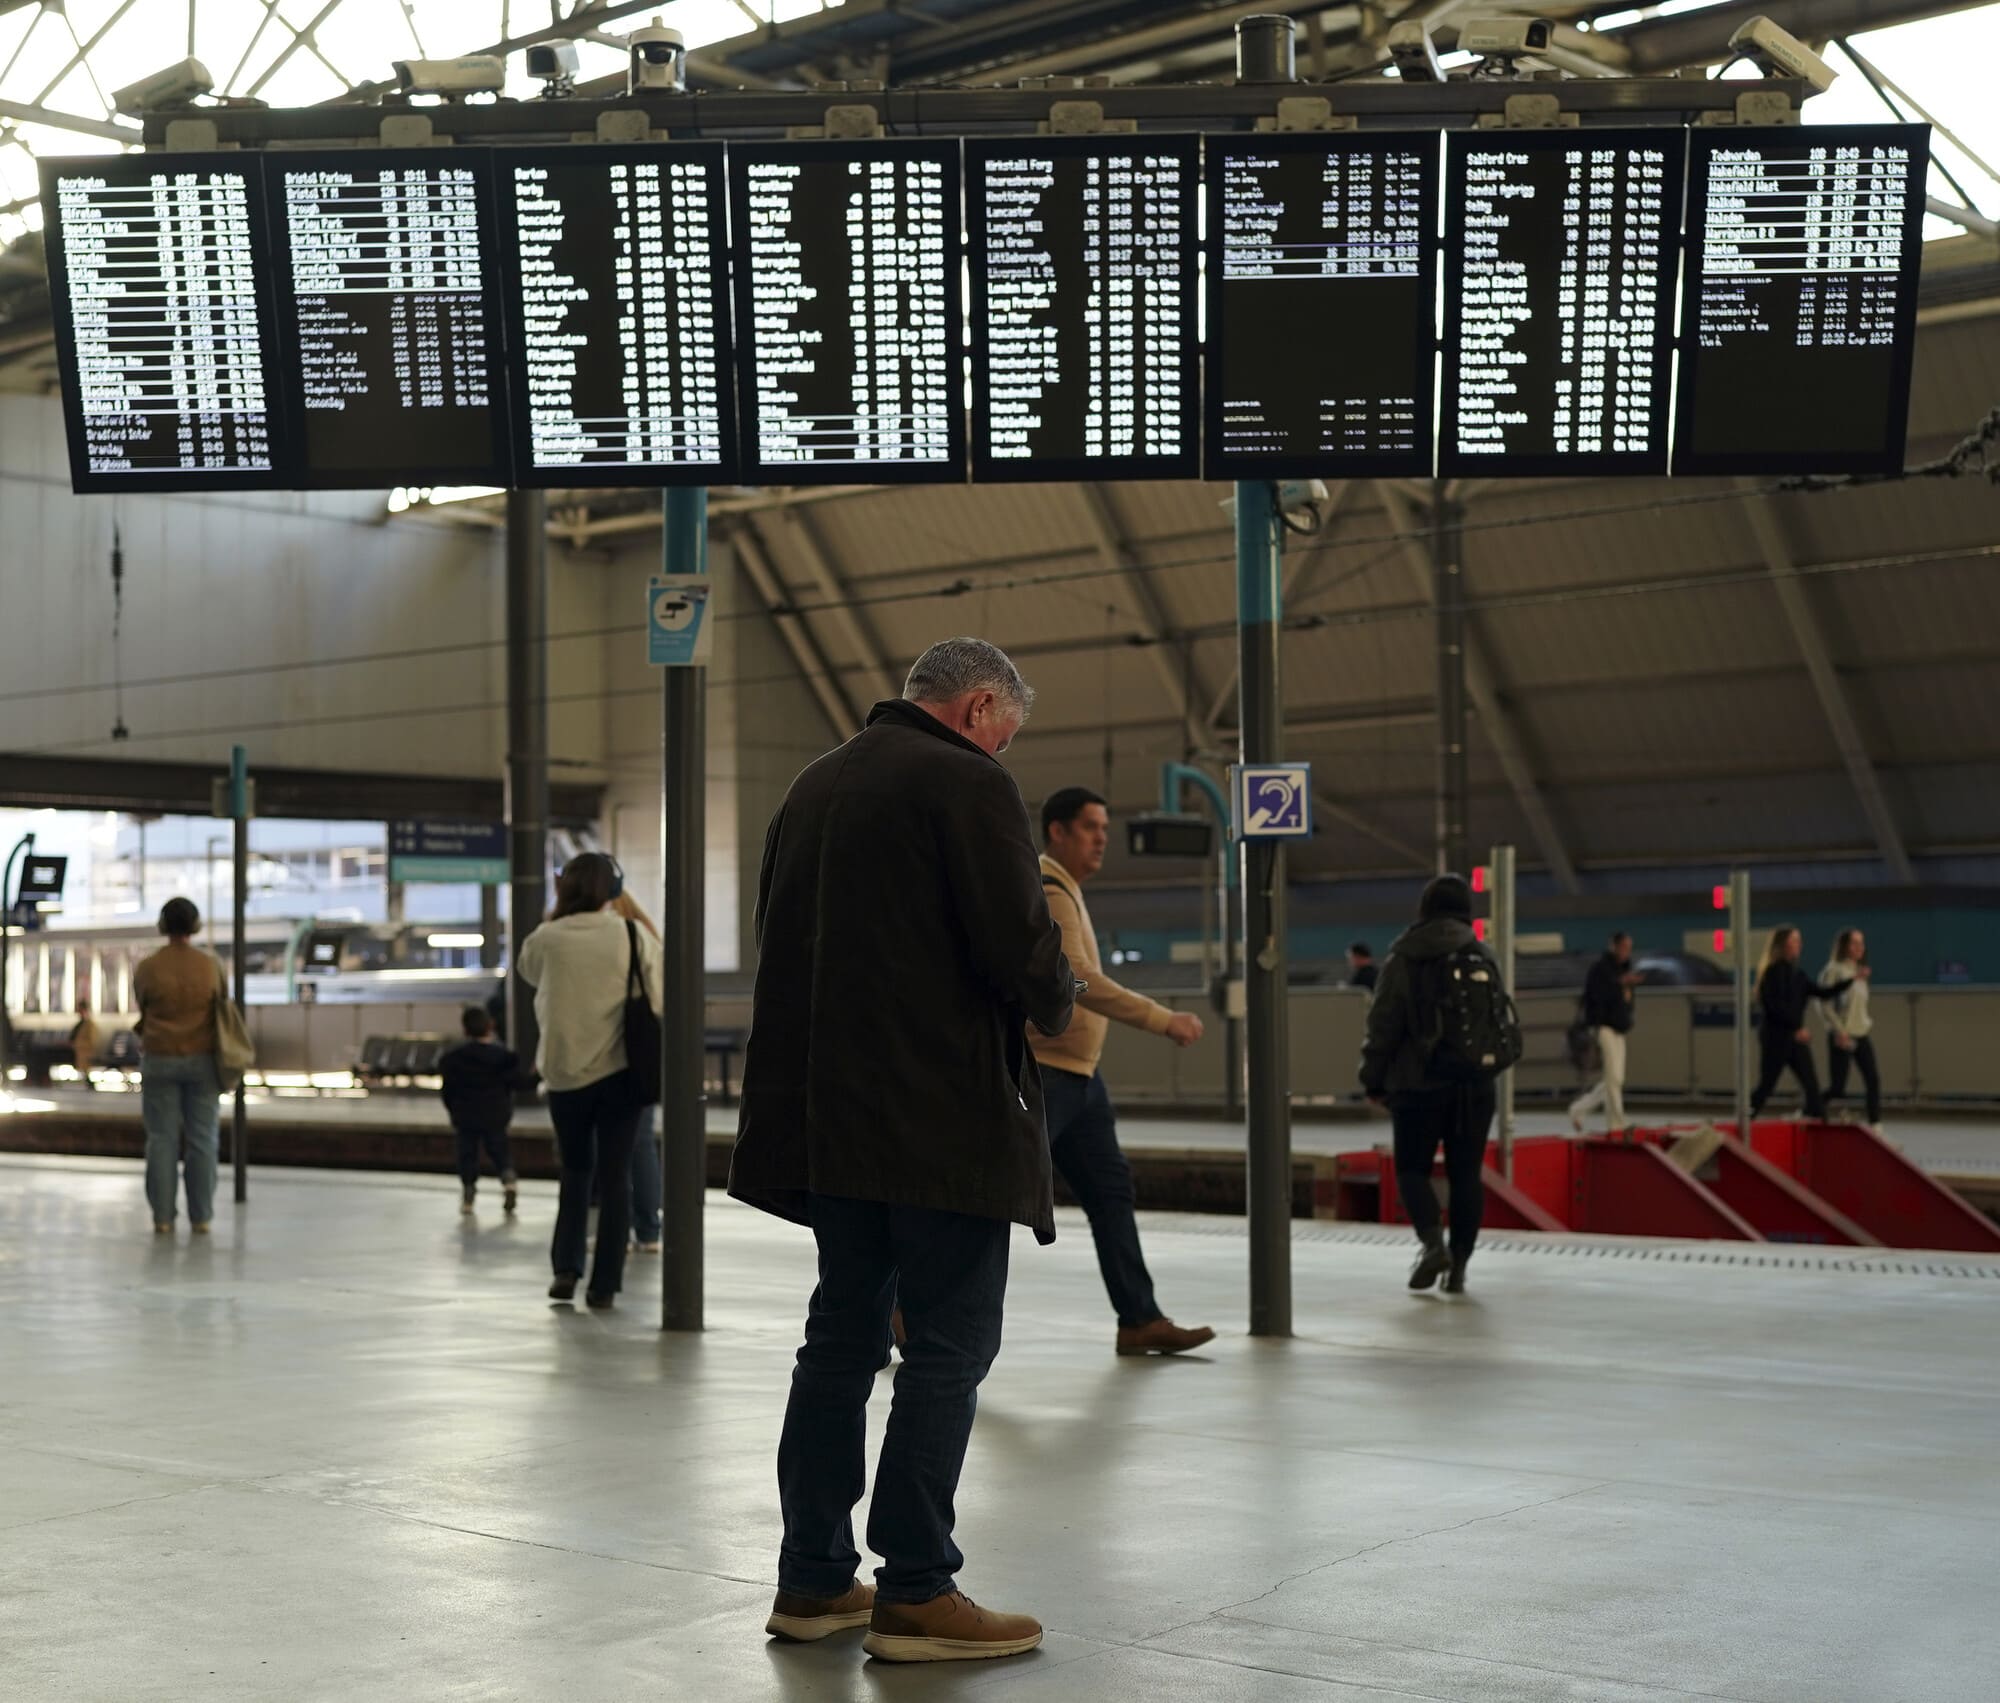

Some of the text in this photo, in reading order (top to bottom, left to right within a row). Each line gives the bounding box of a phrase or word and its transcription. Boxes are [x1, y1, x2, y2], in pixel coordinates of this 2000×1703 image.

[1711, 149, 1761, 162] Todmorden
[1873, 147, 1885, 159] On
[1889, 147, 1908, 159] time
[1144, 156, 1157, 168] On
[1159, 156, 1179, 168] time
[285, 173, 317, 185] Bristol
[439, 169, 451, 181] On
[454, 169, 473, 181] time
[1467, 168, 1505, 180] Saltaire
[1628, 166, 1640, 178] On
[1643, 165, 1662, 178] time
[1710, 165, 1755, 177] Wakefield
[1872, 163, 1884, 175] On
[1887, 163, 1907, 175] time
[210, 174, 222, 186] On
[224, 174, 243, 186] time
[671, 180, 684, 191] On
[686, 179, 706, 191] time
[1709, 180, 1754, 193] Wakefield
[1756, 180, 1779, 192] West
[1870, 179, 1882, 190] On
[1886, 178, 1905, 190] time
[211, 190, 223, 202] On
[226, 189, 245, 201] time
[286, 188, 318, 200] Bristol
[440, 184, 453, 196] On
[454, 184, 474, 196] time
[1466, 184, 1497, 196] Sandal
[1627, 182, 1639, 193] On
[1642, 181, 1662, 193] time
[673, 210, 686, 222] On
[687, 210, 708, 222] time
[986, 206, 1034, 217] Lancaster
[1144, 203, 1157, 215] On
[1160, 202, 1179, 214] time
[987, 221, 1023, 235] Langley
[1145, 218, 1157, 230] On
[1160, 218, 1179, 229] time
[1384, 215, 1396, 226] On
[1399, 214, 1418, 226] time
[1465, 215, 1509, 227] Sheffield
[1625, 212, 1637, 224] On
[1640, 212, 1660, 224] time
[1006, 237, 1034, 248] Green
[1135, 234, 1153, 247] Exp
[1225, 233, 1272, 245] Newcastle
[1374, 230, 1392, 244] Exp
[1373, 246, 1392, 260] Exp
[1464, 247, 1498, 260] Skipton
[1624, 243, 1636, 255] On
[1638, 243, 1658, 255] time
[293, 263, 339, 275] Carnforth
[446, 261, 458, 272] On
[460, 260, 479, 272] time
[1383, 261, 1395, 272] On
[1398, 261, 1417, 272] time
[87, 428, 126, 441] Bradford
[129, 428, 152, 440] Inter
[235, 426, 246, 438] On
[248, 426, 267, 438] time
[236, 441, 248, 453] On
[250, 440, 268, 452] time
[238, 455, 249, 467] On
[251, 455, 270, 467] time
[1288, 814, 1298, 827] T
